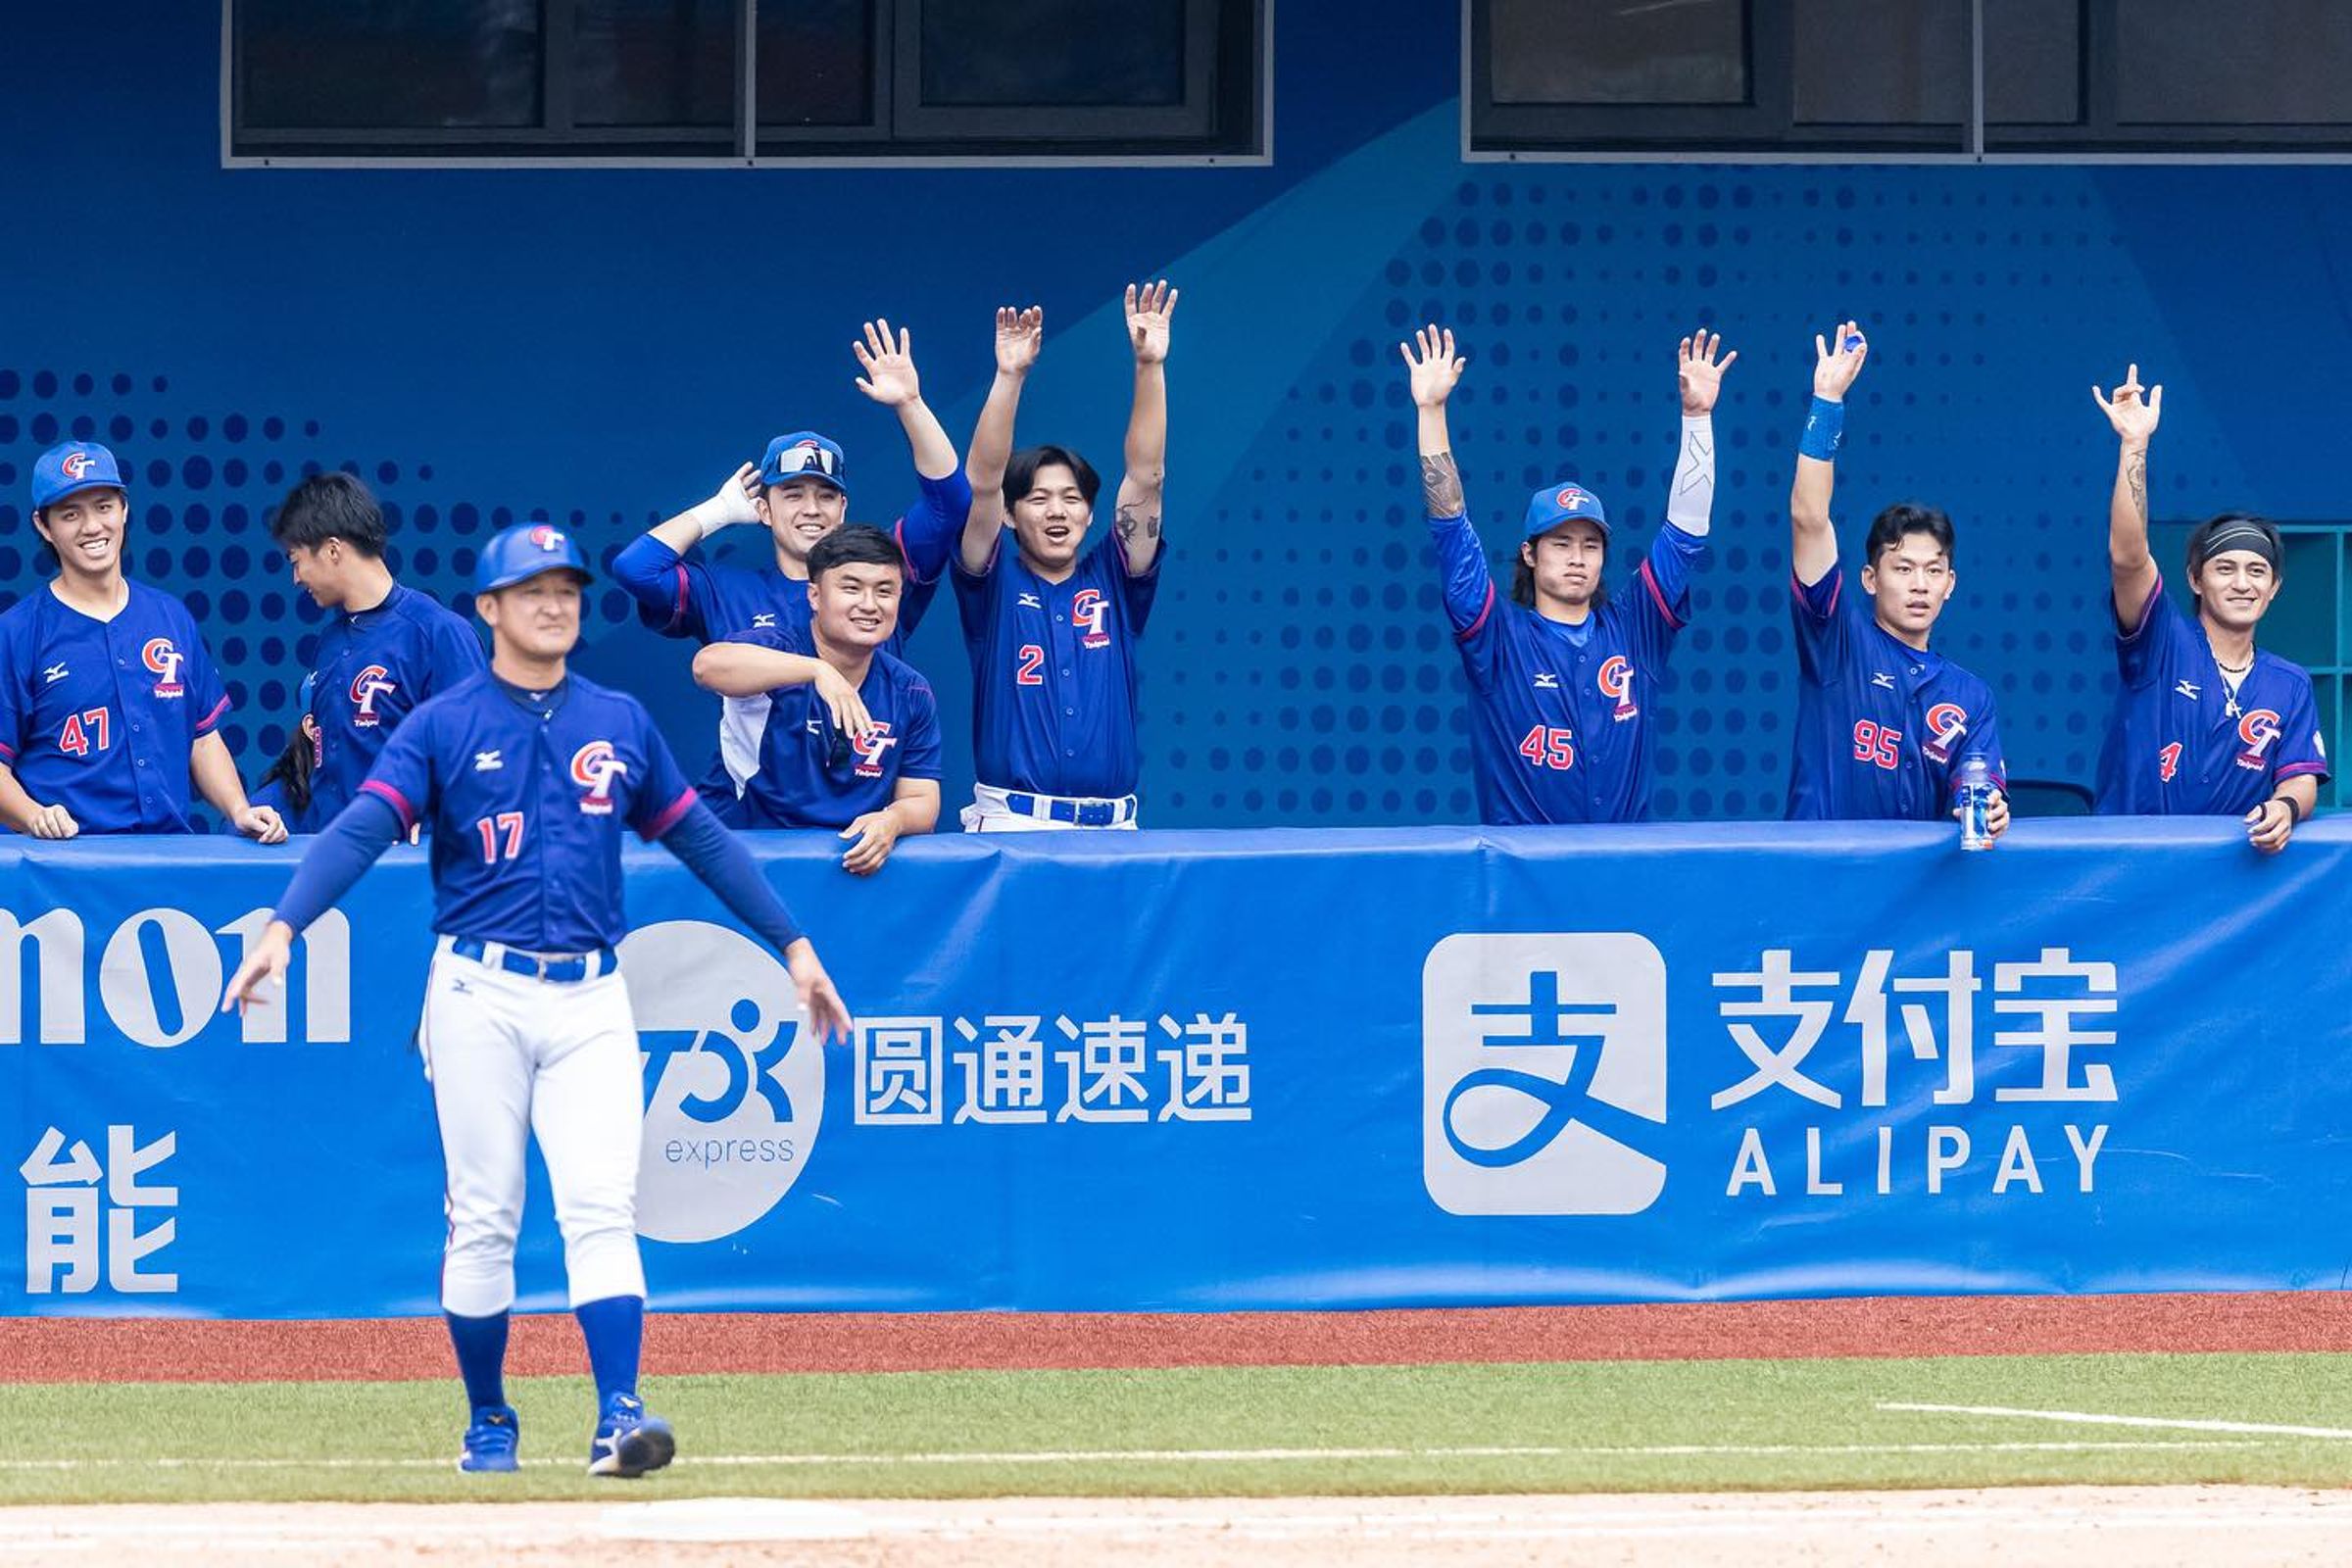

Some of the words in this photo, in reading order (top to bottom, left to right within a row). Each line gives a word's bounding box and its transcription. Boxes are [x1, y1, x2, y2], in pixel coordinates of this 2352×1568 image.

[1017, 645, 1044, 685] 2
[60, 708, 109, 756] 47
[1520, 725, 1573, 769] 45
[1853, 719, 1901, 769] 95
[477, 811, 523, 863] 17
[1711, 948, 2118, 1109] 支付宝
[854, 1012, 1251, 1125] 圆通速递
[665, 1139, 794, 1169] express
[1726, 1125, 2108, 1196] ALIPAY
[19, 1125, 178, 1294] 能
